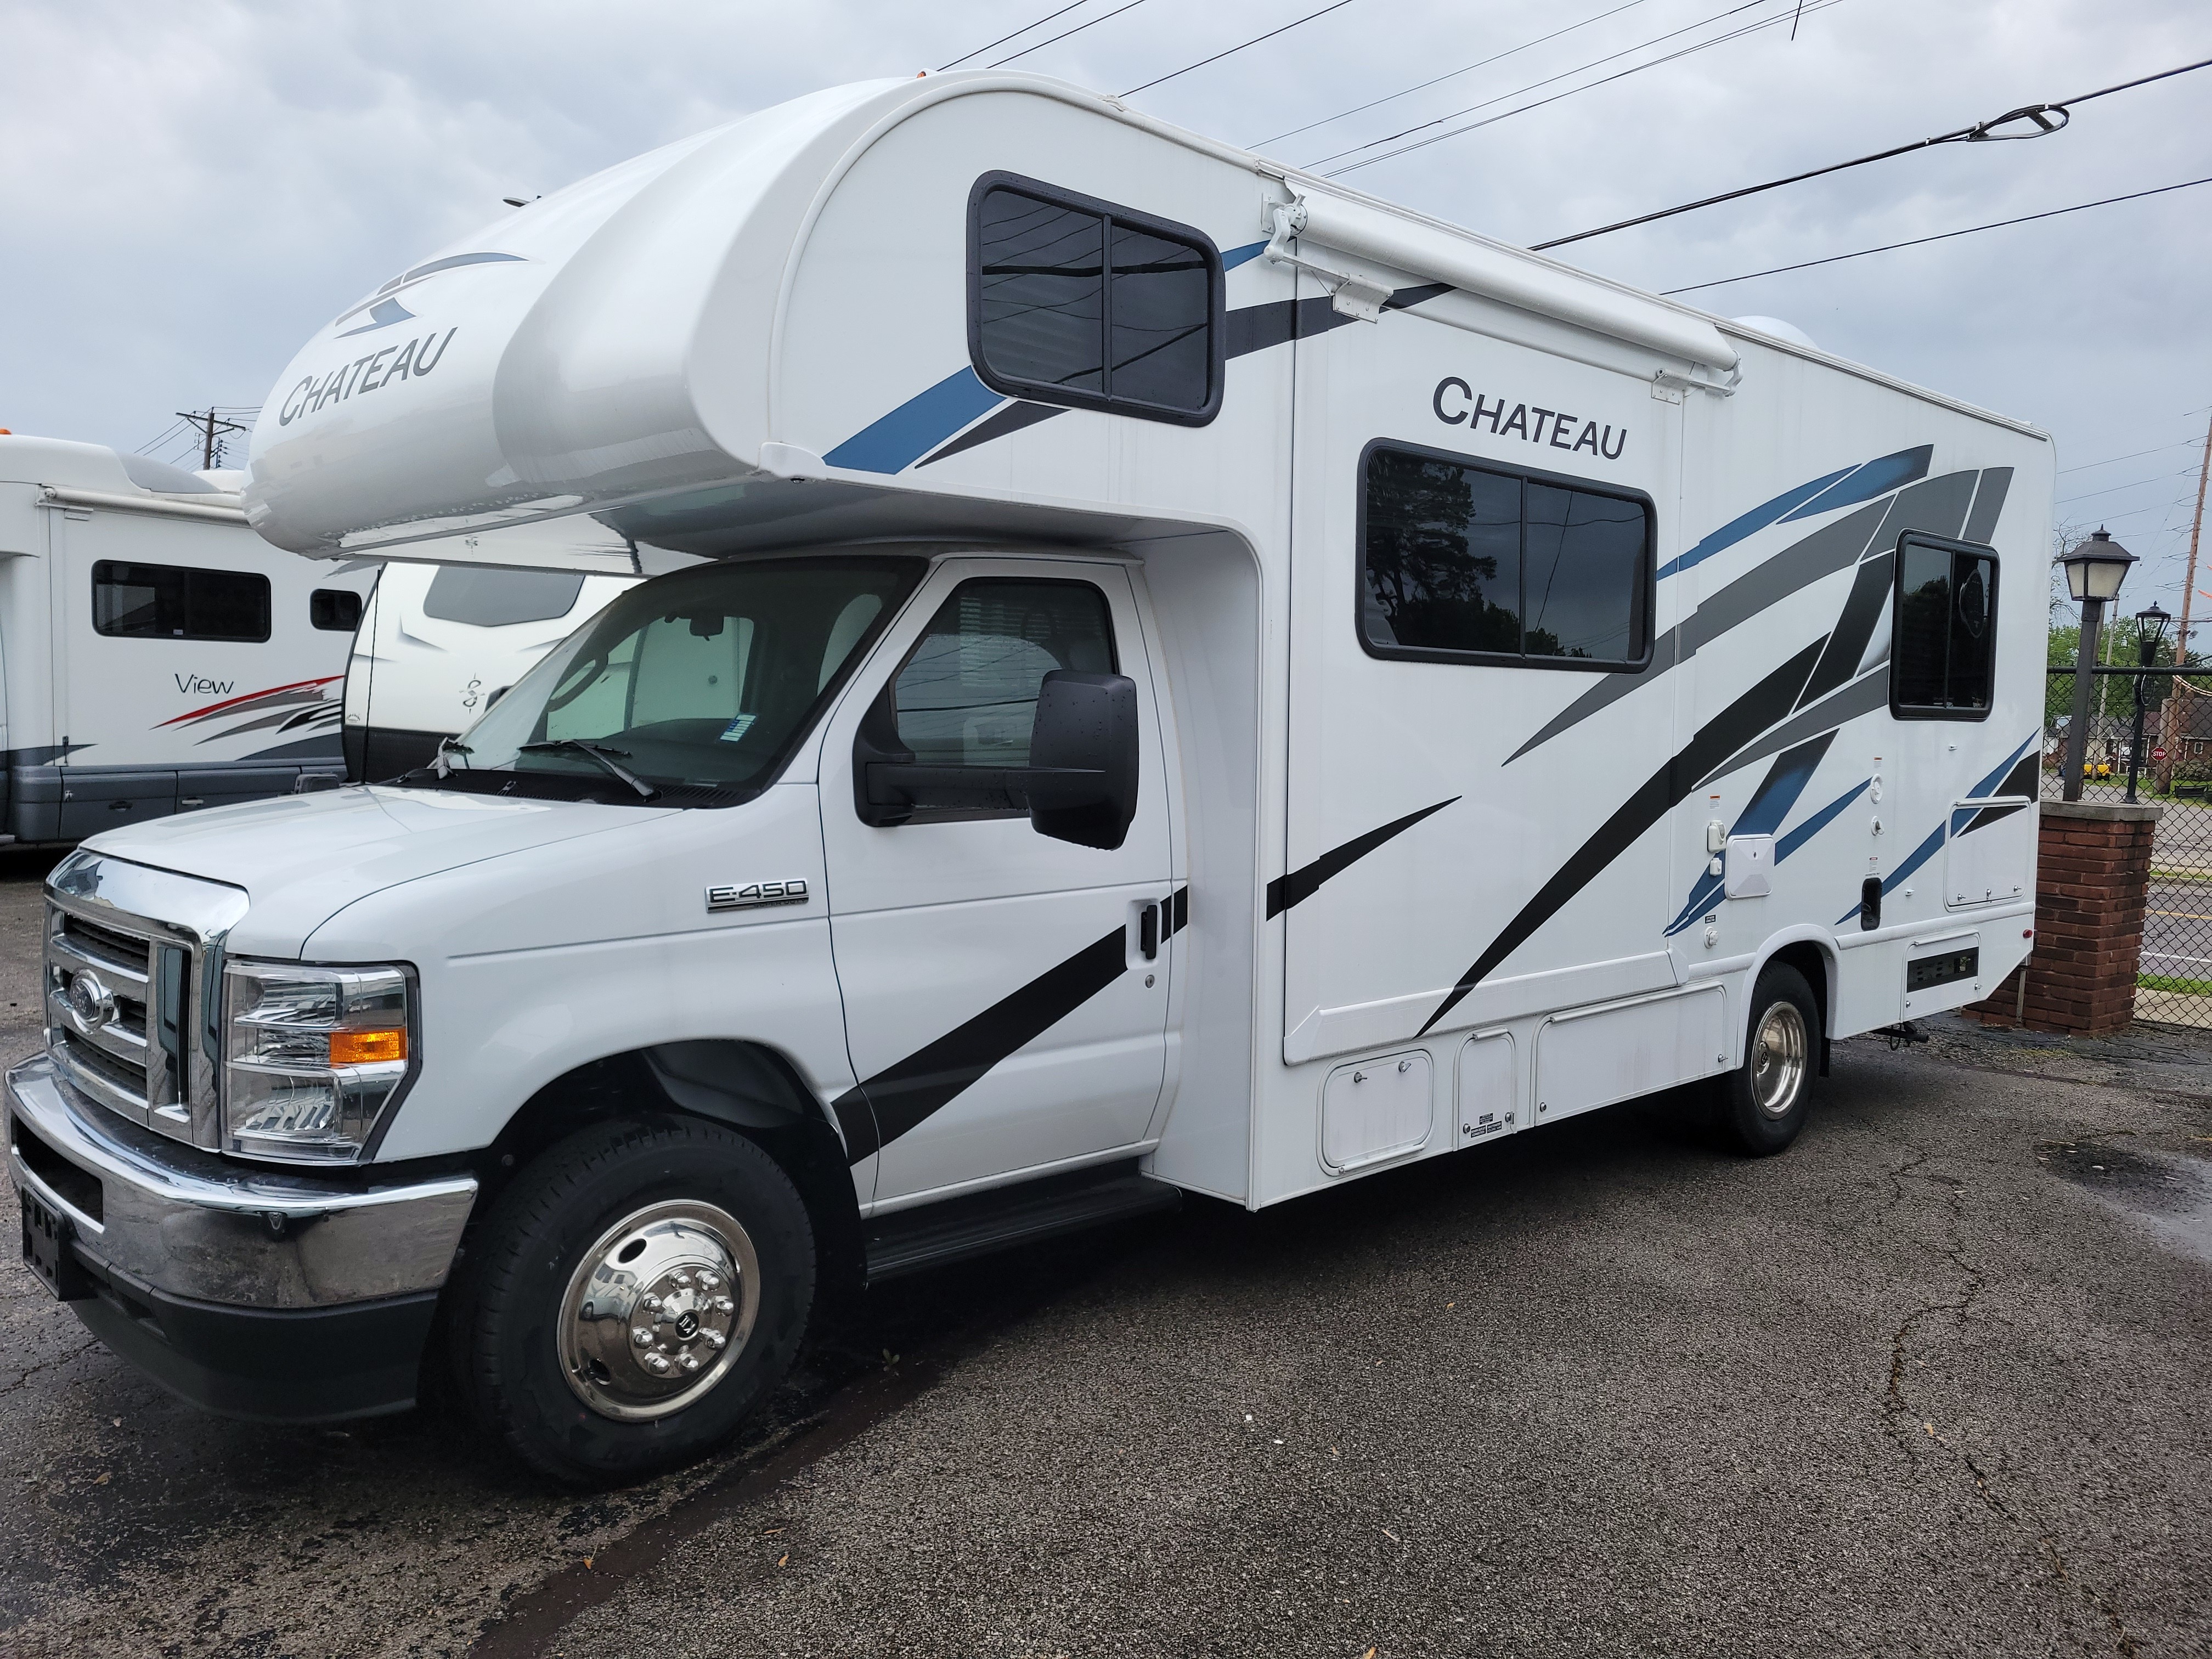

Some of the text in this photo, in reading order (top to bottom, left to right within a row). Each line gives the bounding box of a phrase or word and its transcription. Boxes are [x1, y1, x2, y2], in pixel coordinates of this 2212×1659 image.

[279, 326, 458, 427] CHATEAU
[1433, 376, 1627, 460] CHATEAU
[174, 673, 234, 694] View
[709, 881, 807, 903] E-450
